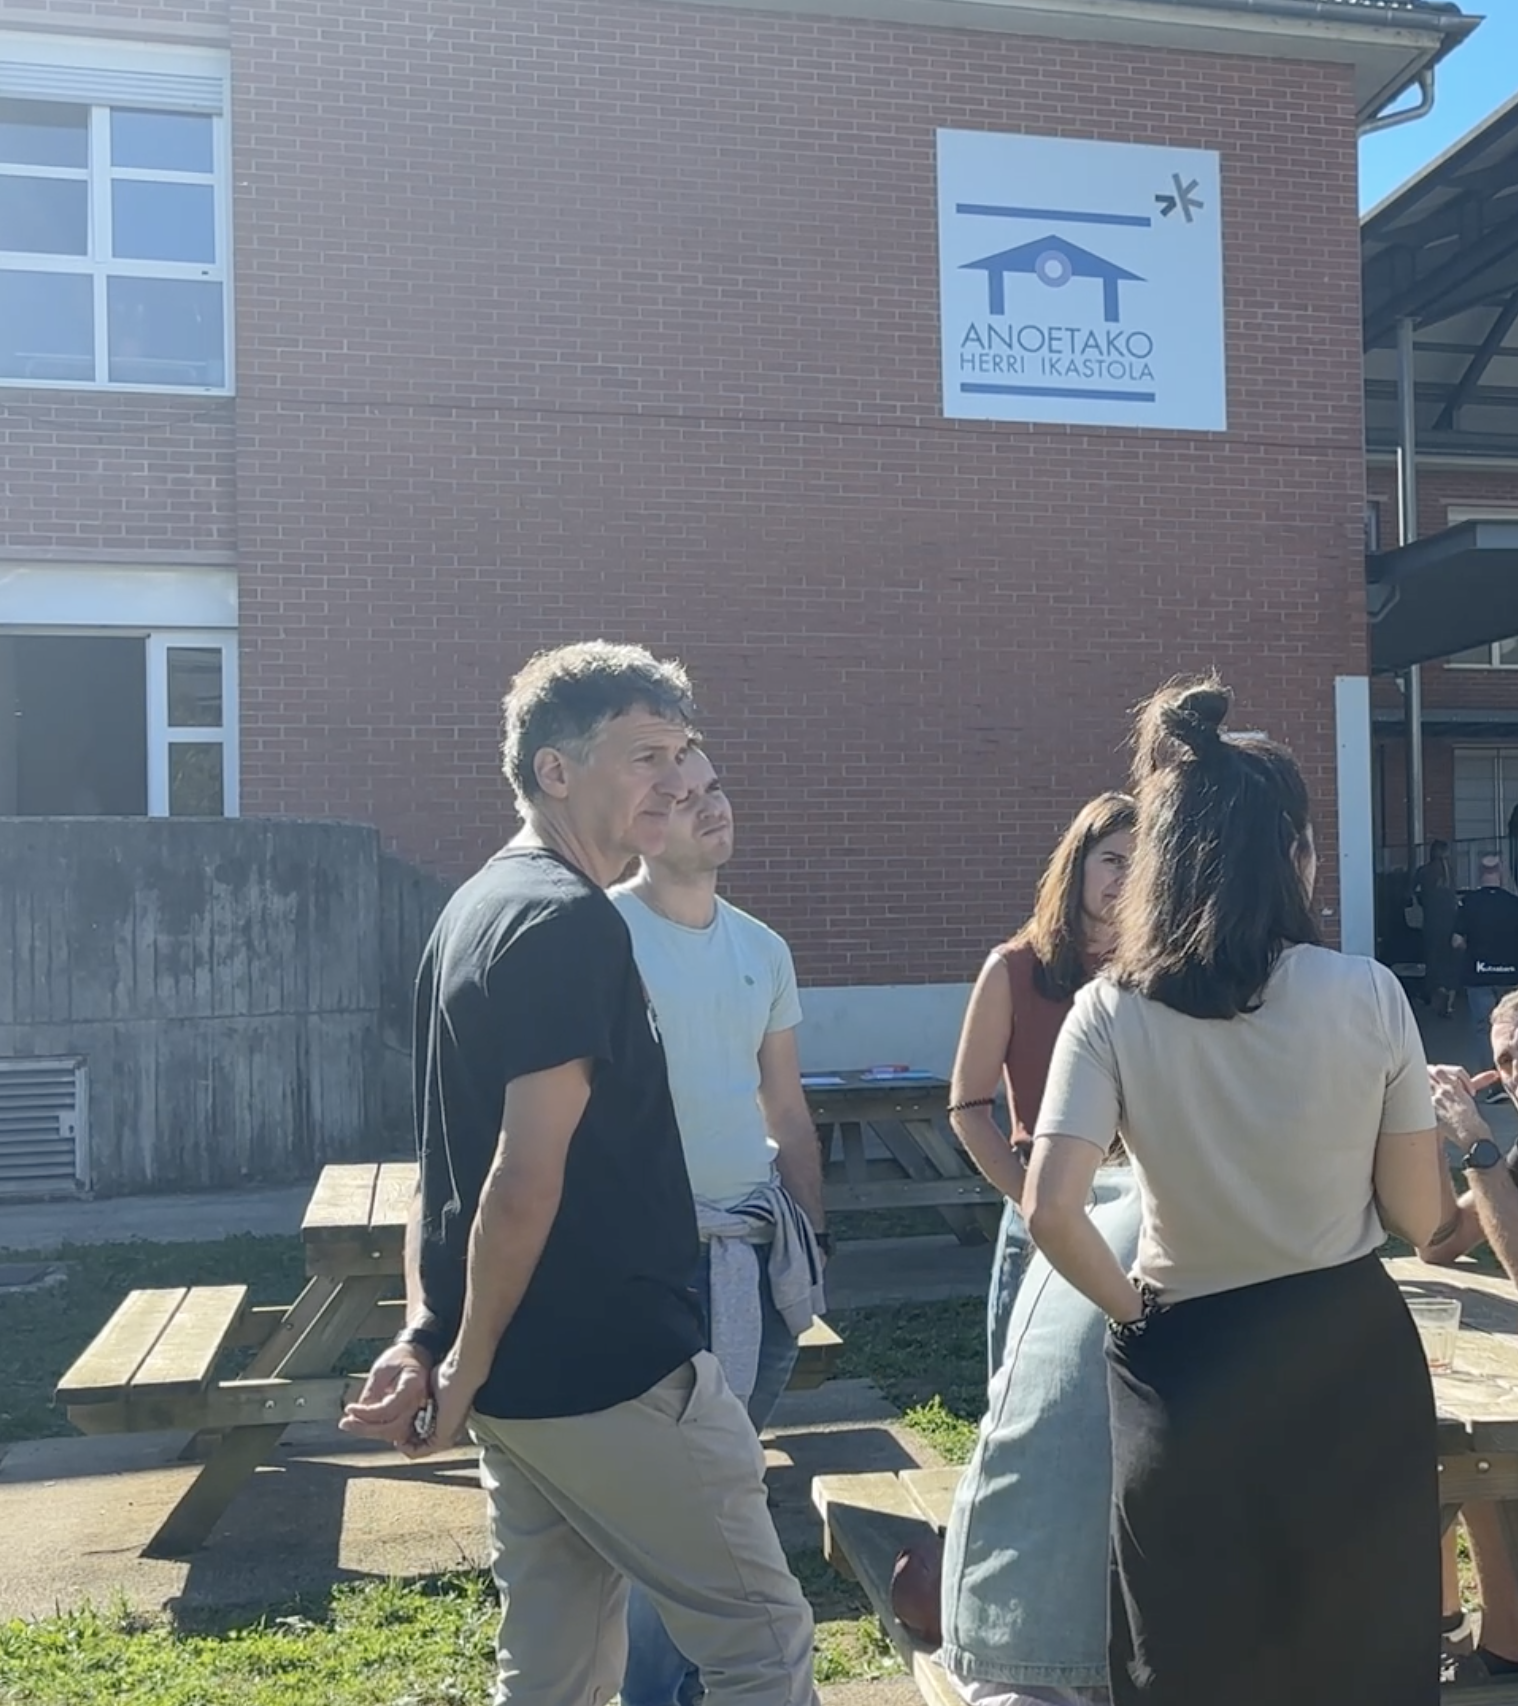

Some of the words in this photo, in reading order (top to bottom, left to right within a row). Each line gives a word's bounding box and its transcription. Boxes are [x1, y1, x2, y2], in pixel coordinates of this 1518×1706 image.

[960, 321, 1154, 359] ANOETAKO
[959, 352, 1026, 374] HERRI
[1041, 356, 1155, 381] IKASTOLA
